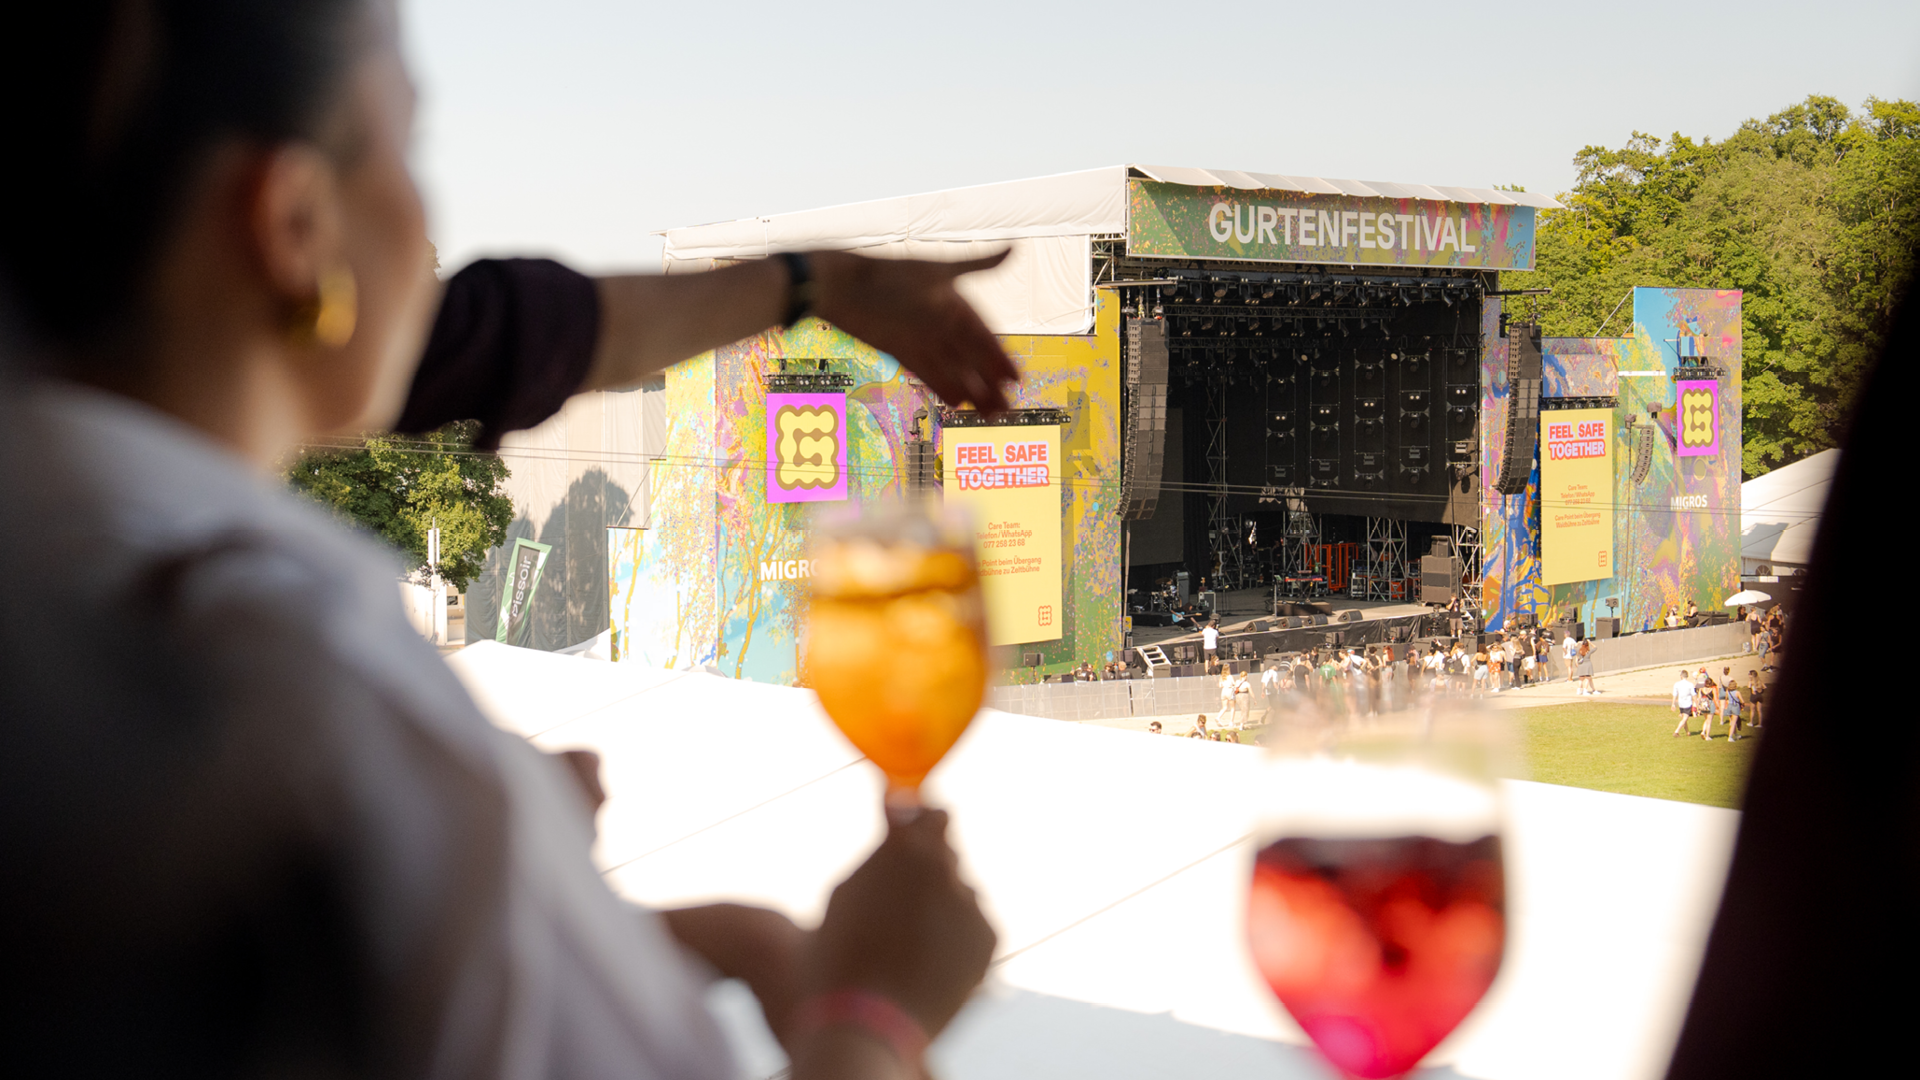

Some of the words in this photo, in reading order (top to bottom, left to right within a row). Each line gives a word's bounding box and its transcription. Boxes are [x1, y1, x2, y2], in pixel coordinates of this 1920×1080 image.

[1209, 202, 1476, 253] GURTENFESTIVAL
[1549, 424, 1574, 439] FEEL
[1578, 422, 1604, 438] SAFE
[957, 444, 998, 465] FEEL
[1004, 443, 1047, 463] SAFE
[1549, 440, 1606, 459] TOGETHER
[956, 465, 1050, 489] TOGETHER
[1670, 494, 1708, 510] MIGROS
[988, 522, 1002, 530] Care
[1003, 521, 1021, 529] Team:
[1001, 529, 1032, 538] WhatsApp
[983, 540, 995, 549] 077
[996, 539, 1007, 548] 258
[1008, 539, 1016, 547] 23
[982, 559, 998, 567] Point
[998, 558, 1013, 566] beim
[1014, 555, 1042, 566] Übergang
[760, 559, 820, 581] MIGRO
[1011, 565, 1040, 574] Zeltbühne
